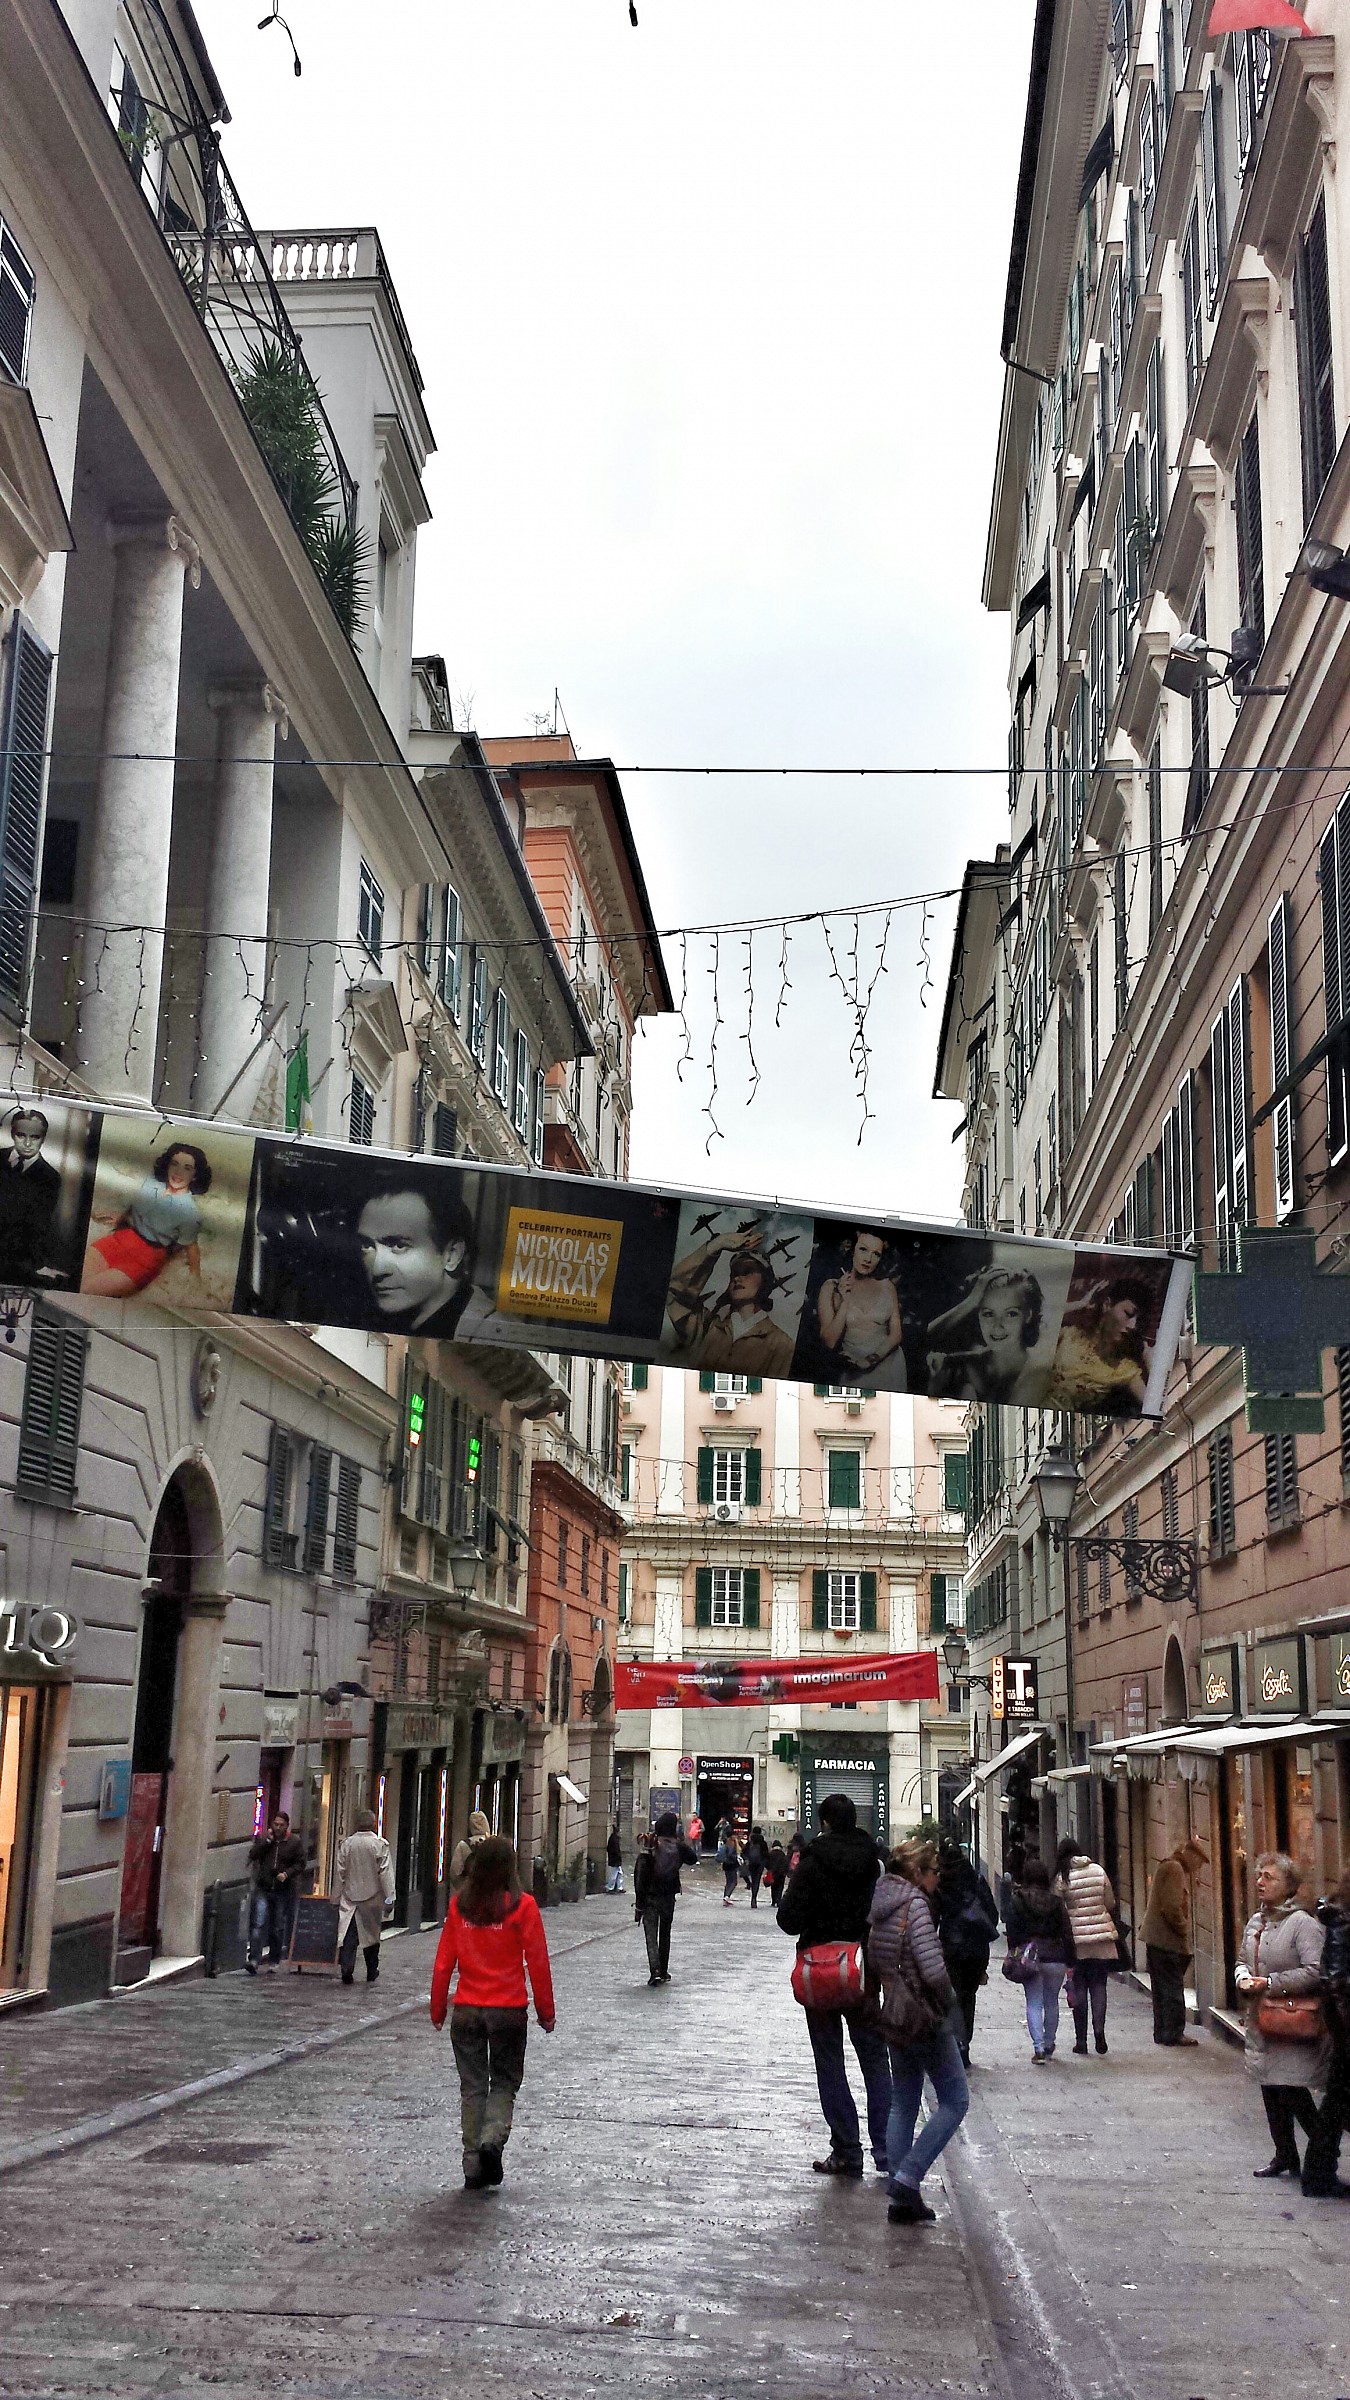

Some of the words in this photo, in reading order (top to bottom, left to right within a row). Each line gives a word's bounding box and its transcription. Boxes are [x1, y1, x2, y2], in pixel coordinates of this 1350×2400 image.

[519, 1222, 564, 1234] CELEBRITY
[565, 1227, 612, 1241] PORTRAITS
[515, 1232, 610, 1267] NICKOLAS
[510, 1255, 606, 1298] MURAY
[509, 1289, 538, 1301] Genova
[540, 1293, 570, 1305] Palazzo
[793, 1670, 887, 1685] imaginarium
[994, 1658, 1002, 1709] LOTTO
[1008, 1662, 1031, 1700] T
[814, 1759, 876, 1771] FARMACIA
[878, 1783, 886, 1832] FARMACIA
